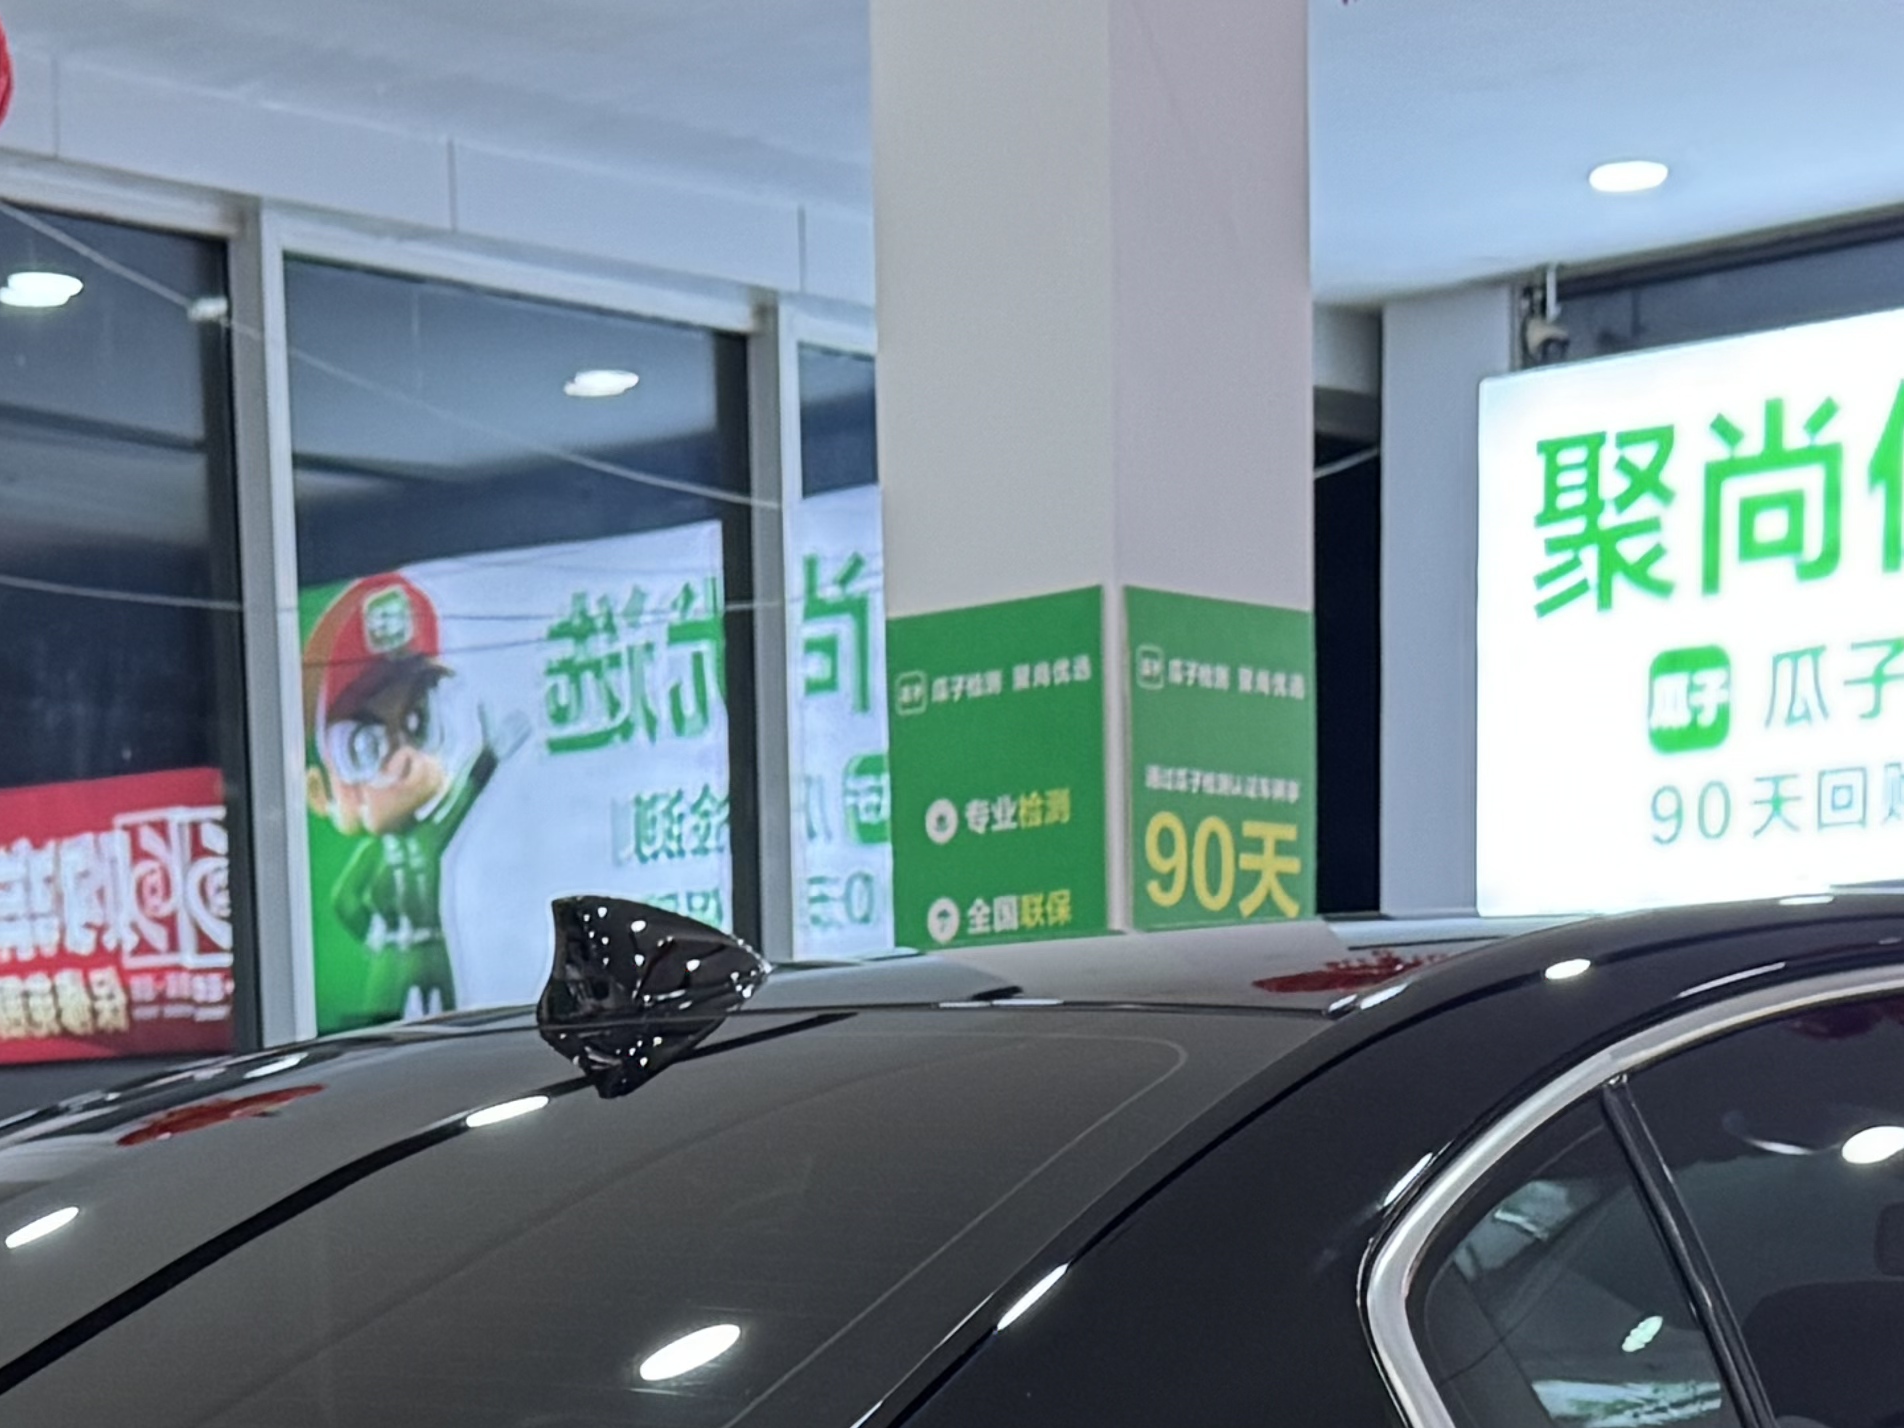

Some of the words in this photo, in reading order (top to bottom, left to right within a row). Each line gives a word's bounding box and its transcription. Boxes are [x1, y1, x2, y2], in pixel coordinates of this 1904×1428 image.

[964, 788, 1072, 835] 专业检测
[1144, 810, 1302, 920] 90天
[966, 890, 1073, 936] 全国联保
